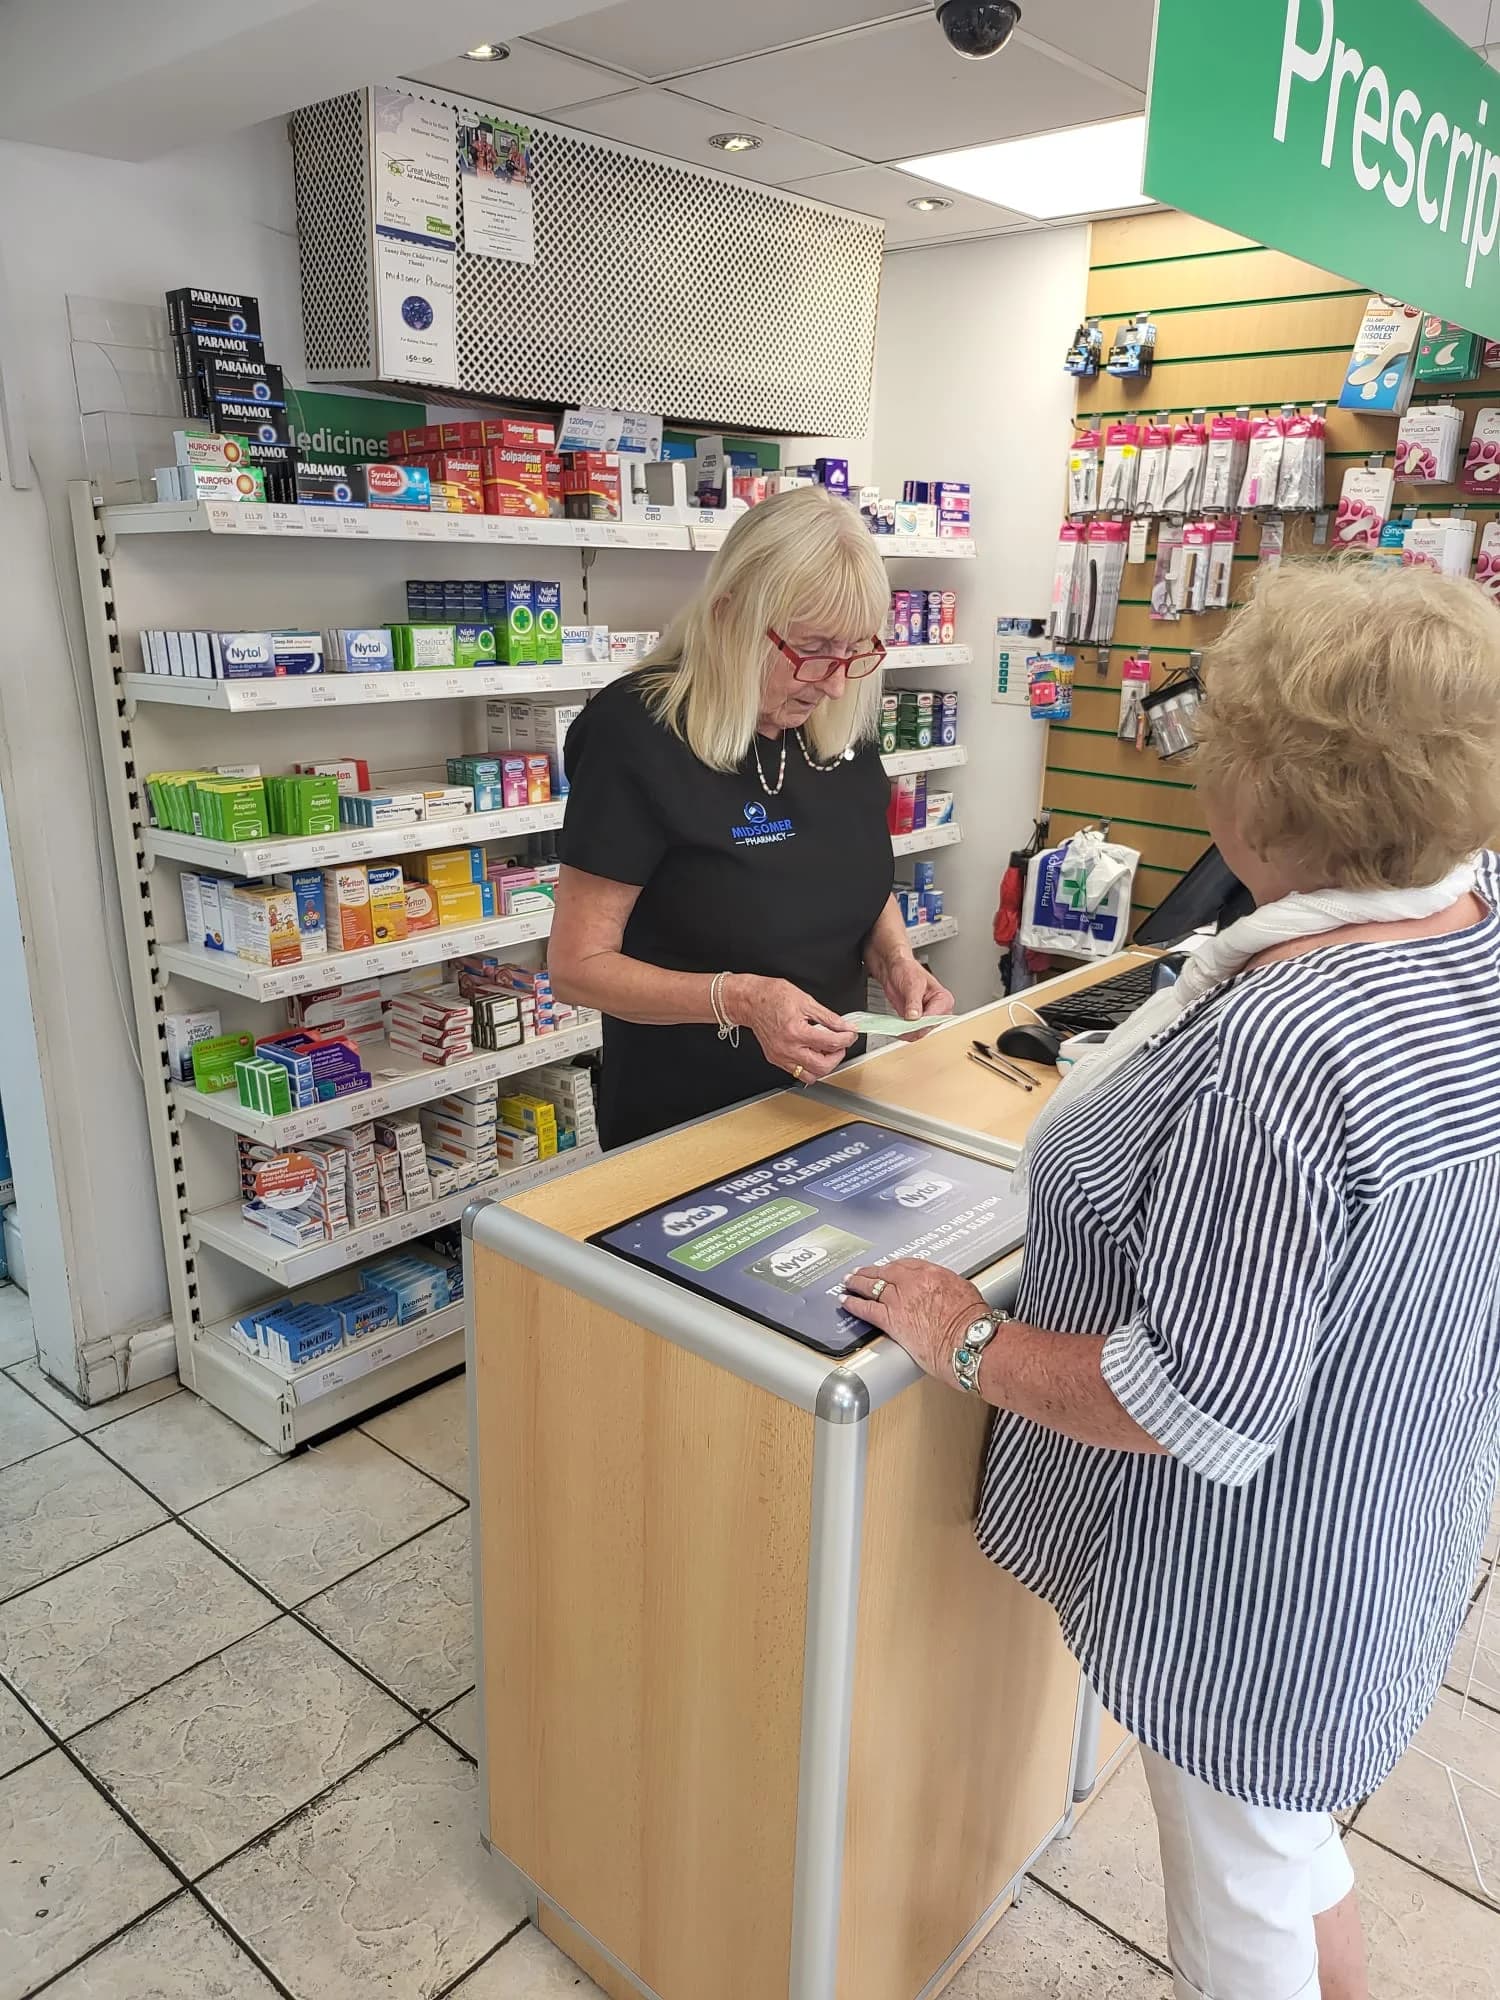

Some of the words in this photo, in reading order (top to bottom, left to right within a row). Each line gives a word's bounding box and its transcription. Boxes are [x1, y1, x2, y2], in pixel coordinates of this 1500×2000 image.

[191, 290, 242, 308] PARAMOL
[199, 335, 248, 352] PARAMOL
[216, 359, 266, 376] PARAMOL
[222, 403, 272, 419] PARAMOL
[189, 443, 221, 455] NUROFEN
[290, 424, 390, 463] edicines
[501, 450, 542, 467] Solpadeine
[298, 463, 347, 480] PARAMOL
[371, 470, 398, 479] Syndol
[447, 460, 480, 474] Solpadeine
[525, 464, 543, 477] PLUS
[201, 476, 233, 488] NUROFEN
[644, 512, 662, 522] CBD
[510, 590, 531, 600] Nurse
[514, 582, 531, 593] Night
[541, 588, 559, 598] Night
[537, 595, 559, 605] Nurse
[231, 646, 263, 662] Nytol
[355, 642, 382, 657] Nytol
[233, 802, 257, 812] Aspirin
[311, 799, 332, 808] Aspirin
[732, 819, 793, 839] MIDSOMER
[745, 832, 788, 846] PHARMACY
[370, 870, 395, 880] Benadryl
[1041, 853, 1063, 907] Pharmacy
[335, 1077, 364, 1093] bazuka
[355, 1167, 375, 1178] Voltarol
[714, 1170, 774, 1196] TIRED
[772, 1157, 800, 1172] OF
[735, 1182, 781, 1203] NOT
[776, 1142, 870, 1186] SLEEPING?
[900, 1181, 943, 1204] Nytol
[357, 1203, 377, 1215] Voltarol
[665, 1207, 717, 1234] Nytol
[890, 1230, 939, 1260] MILLIONS
[936, 1223, 953, 1237] TO
[948, 1211, 976, 1229] HELP
[927, 1228, 970, 1251] NIGHT'S
[965, 1211, 997, 1231] SLEEP
[774, 1248, 818, 1273] Nytol
[401, 1291, 433, 1310] Avomine
